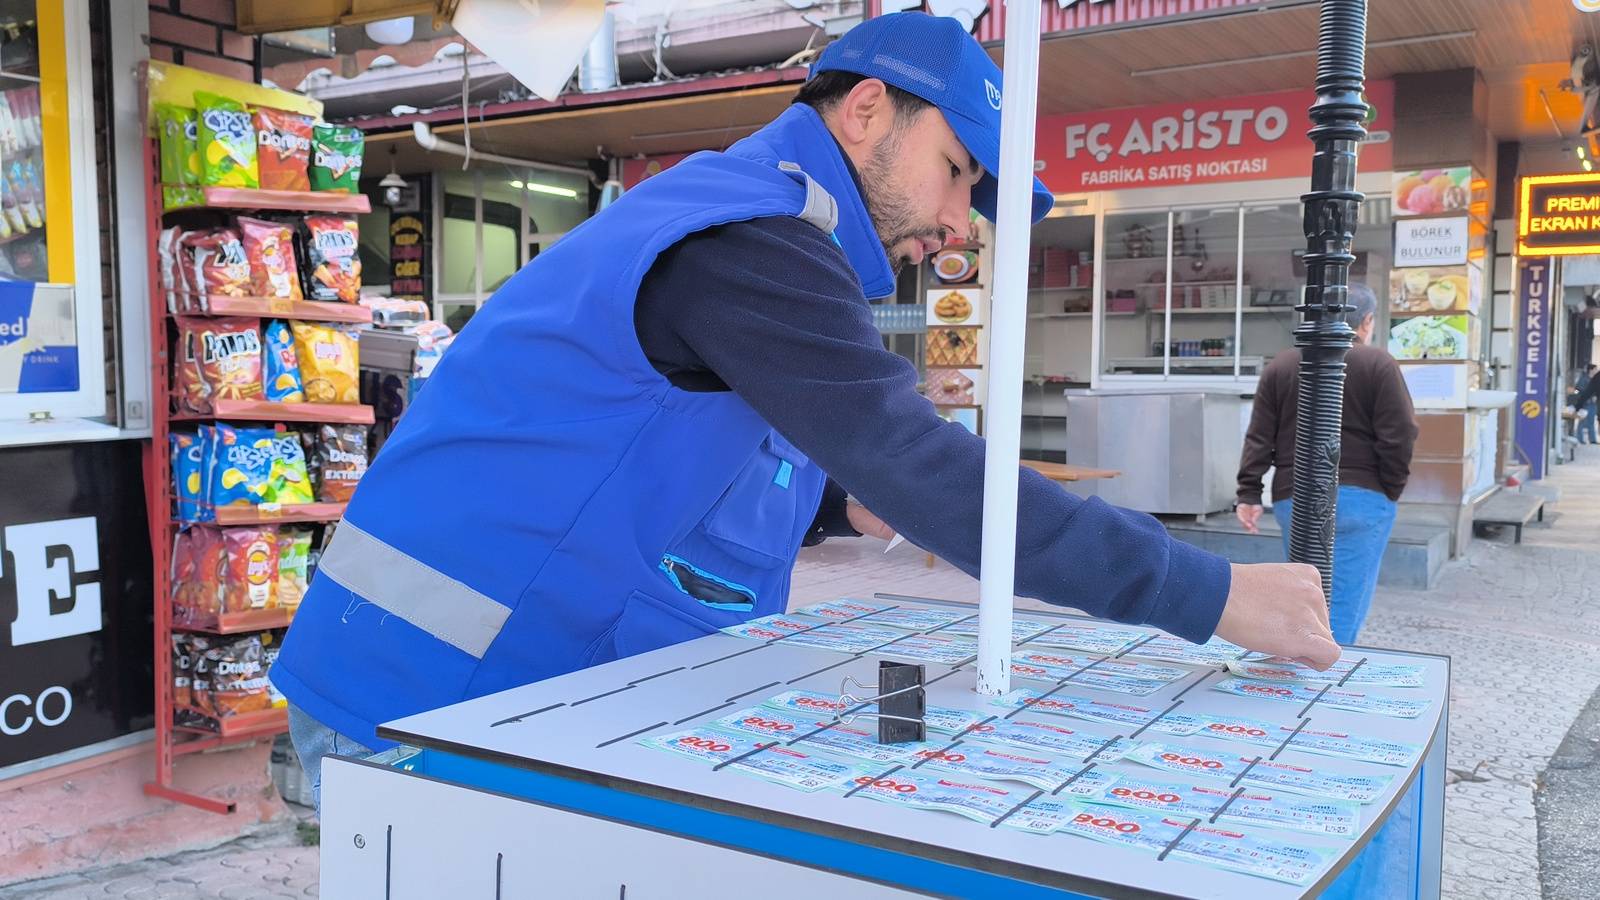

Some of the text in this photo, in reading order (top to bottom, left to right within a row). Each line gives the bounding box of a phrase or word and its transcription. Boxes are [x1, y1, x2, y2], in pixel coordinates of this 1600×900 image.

[1065, 122, 1112, 162] FÇ
[1081, 158, 1267, 185] FABRİKA SATIŞ NOKTASI
[1530, 216, 1588, 232] EKRAN
[1525, 266, 1544, 395] TURKCELL
[743, 717, 794, 730] 800
[1207, 723, 1266, 736] 800
[679, 736, 731, 752] 800
[1160, 753, 1224, 769] 800
[855, 776, 917, 793] 800
[1111, 787, 1181, 803] 800
